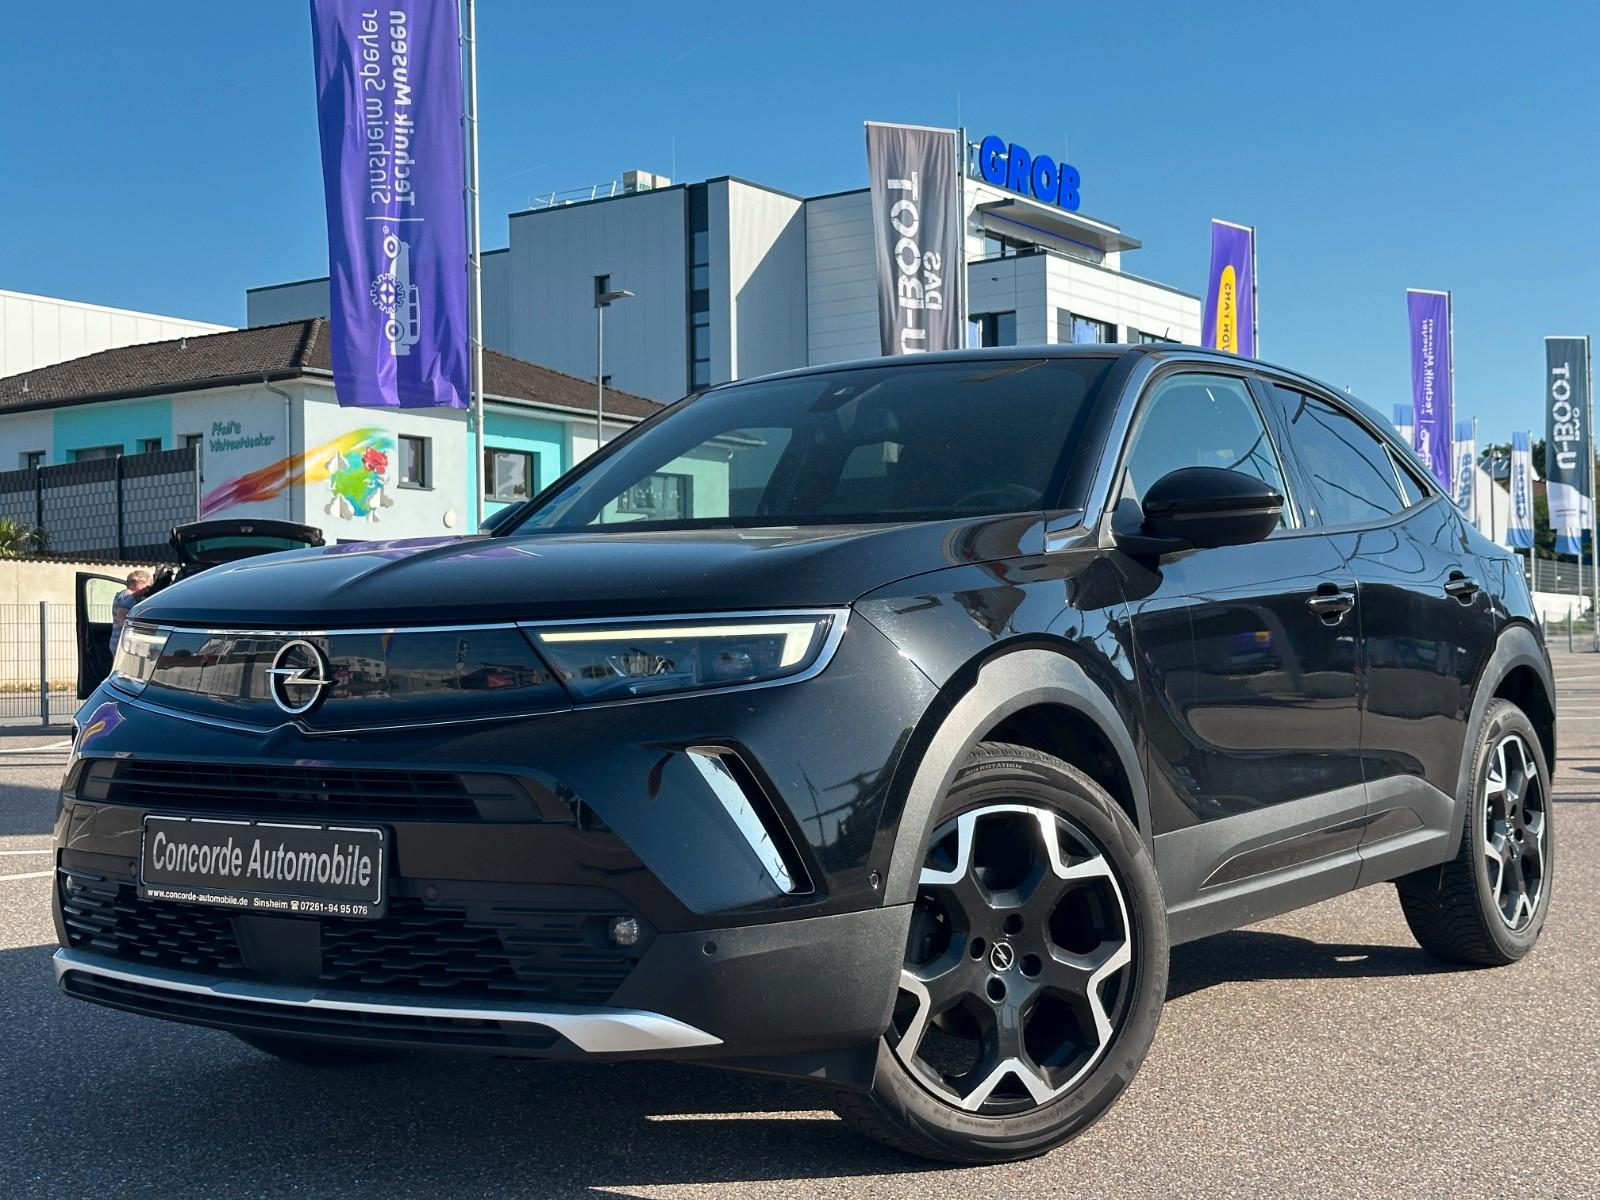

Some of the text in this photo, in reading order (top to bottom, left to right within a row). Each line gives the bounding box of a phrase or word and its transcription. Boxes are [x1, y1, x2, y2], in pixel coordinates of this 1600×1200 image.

[979, 135, 1081, 212] GROB
[152, 831, 372, 887] Concorde Automobile
[147, 889, 368, 915] www.concorde-automobile.de Sinsheim 07261-94 95 076
